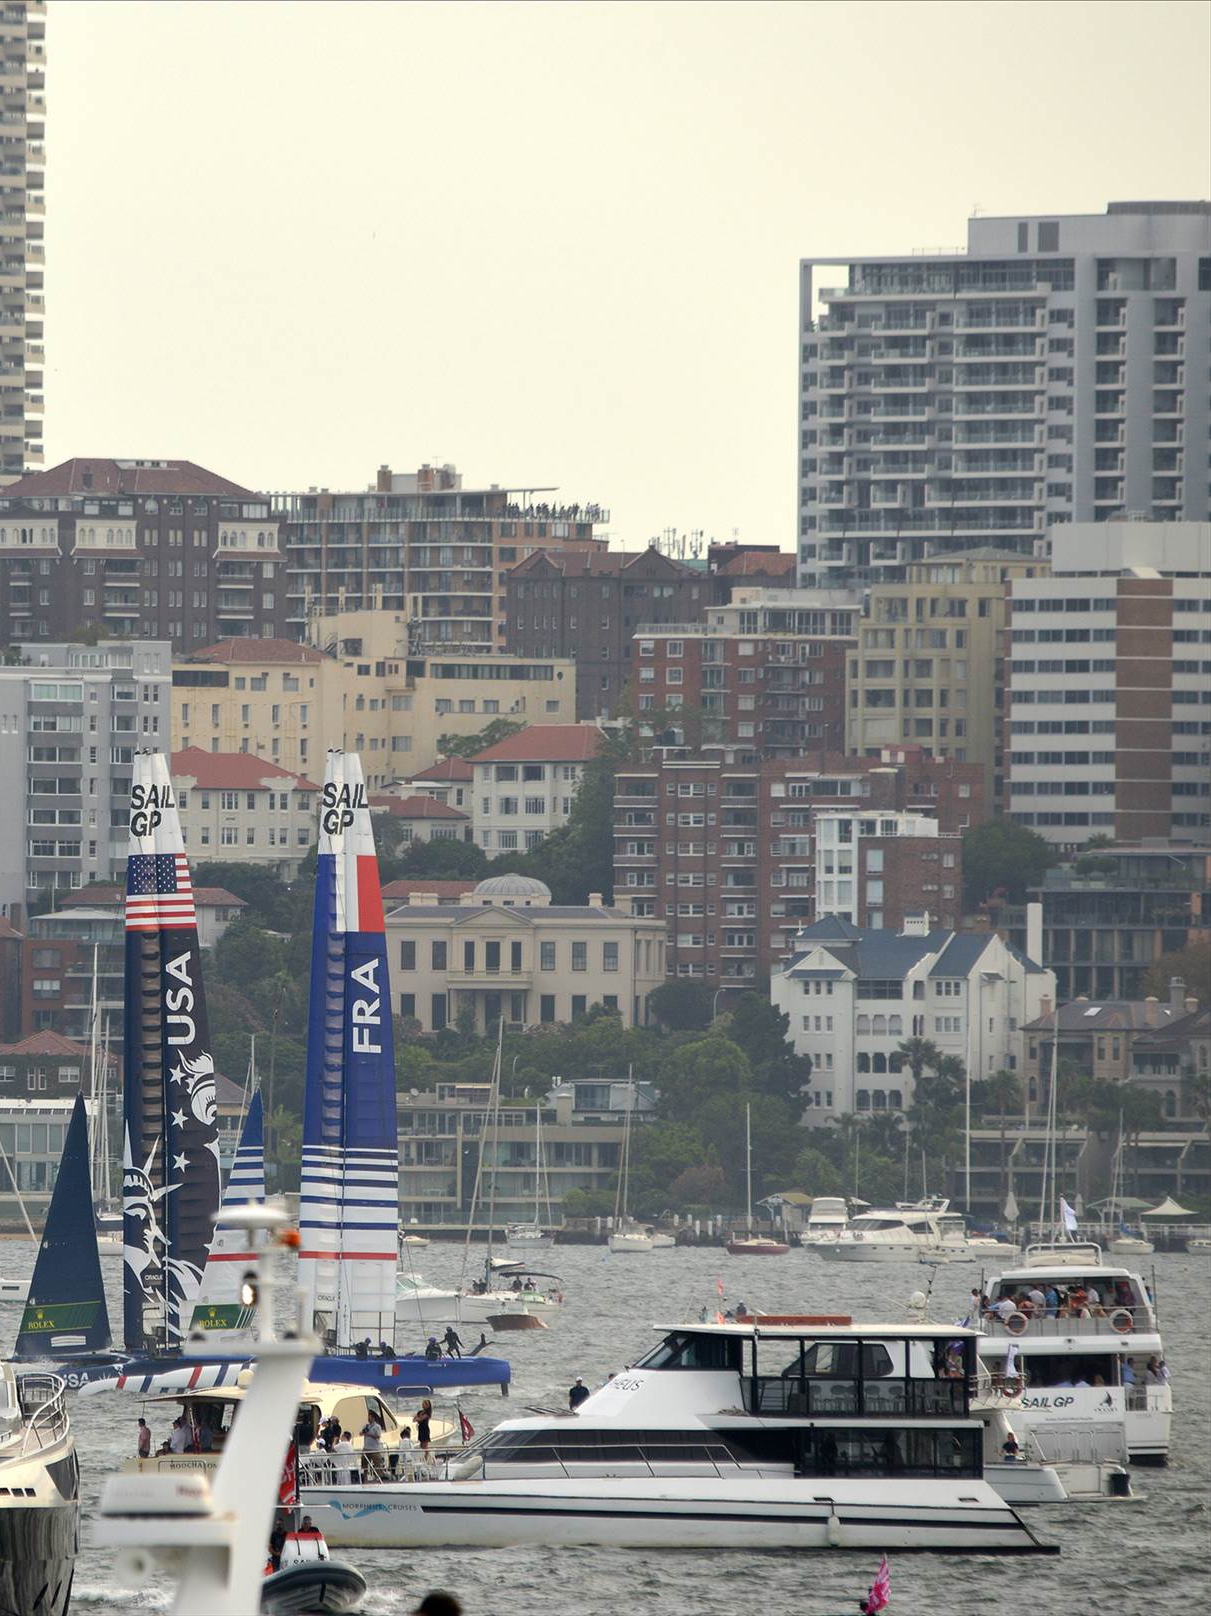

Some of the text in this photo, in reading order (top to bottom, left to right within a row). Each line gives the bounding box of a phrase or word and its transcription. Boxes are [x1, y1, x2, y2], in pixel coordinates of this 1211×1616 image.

[131, 784, 175, 810] SAIL
[322, 782, 368, 809] SAIL
[130, 810, 162, 837] GP
[323, 809, 354, 835] GP
[166, 951, 196, 1045] USA
[351, 958, 382, 1053] FRA
[28, 1320, 55, 1329] ROLEX
[197, 1319, 227, 1328] ROLEX
